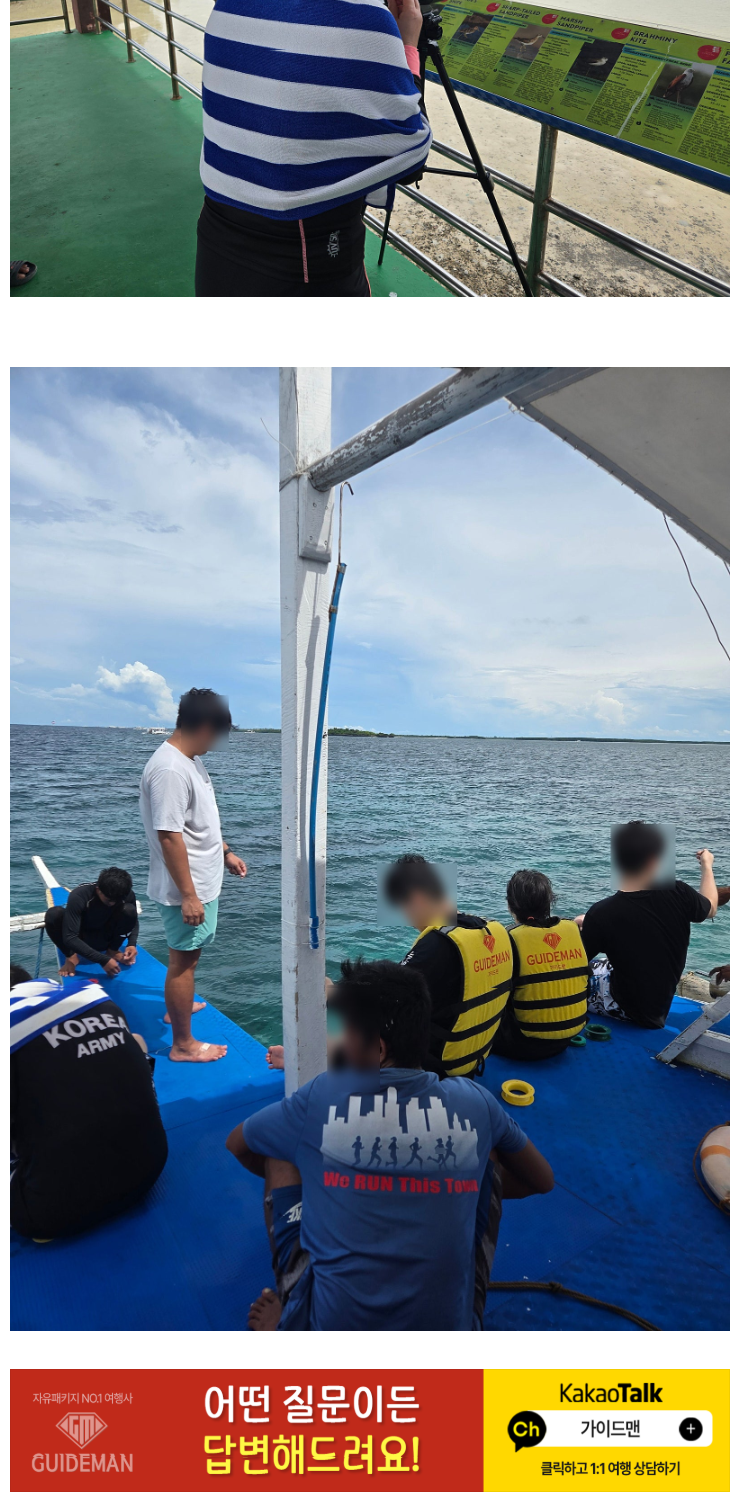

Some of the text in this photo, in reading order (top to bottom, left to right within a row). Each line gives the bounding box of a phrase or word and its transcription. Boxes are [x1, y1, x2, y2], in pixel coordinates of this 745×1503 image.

[499, 9, 529, 20] SANDPIPER
[560, 16, 583, 25] MARSH
[556, 21, 594, 33] SANDPIPER
[630, 36, 647, 45] KITE
[633, 30, 678, 44] BRAHMINY
[473, 950, 511, 973] GUIDEMAN
[526, 948, 583, 966] GUIDEMAN
[42, 1013, 130, 1048] KOREA
[77, 1032, 126, 1058] ARMY
[323, 1171, 479, 1194] We RUN This Town
